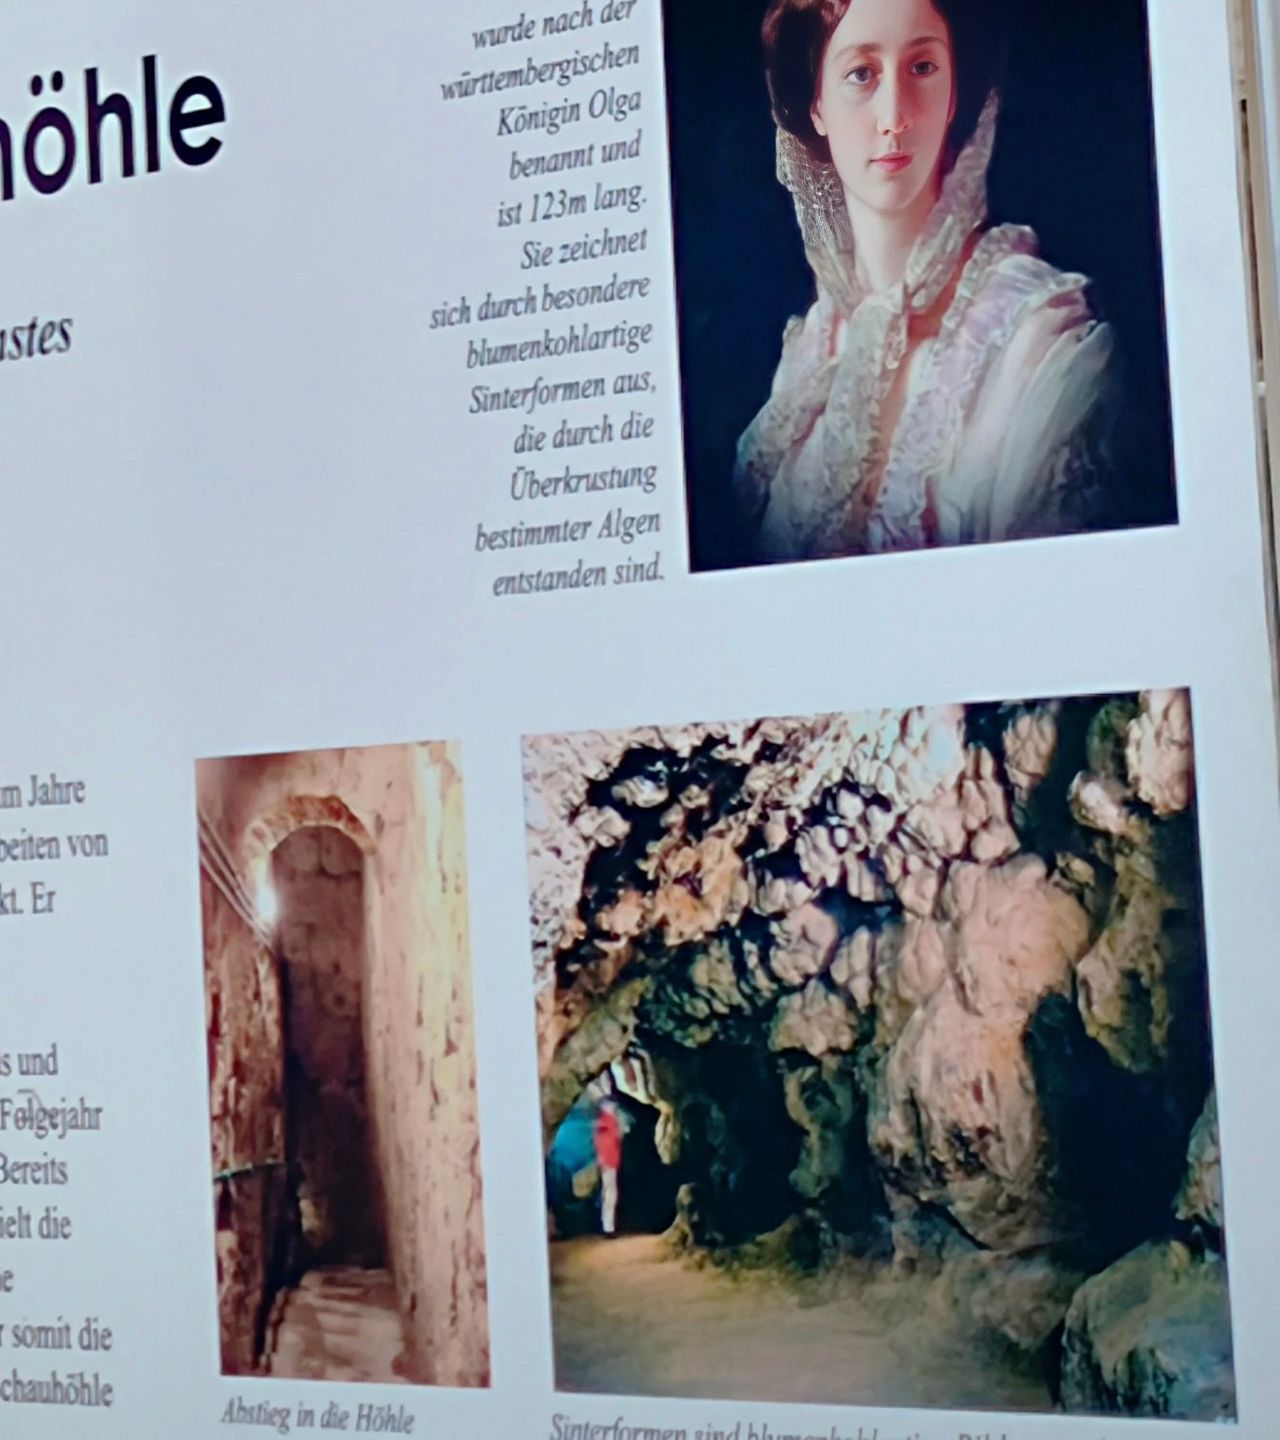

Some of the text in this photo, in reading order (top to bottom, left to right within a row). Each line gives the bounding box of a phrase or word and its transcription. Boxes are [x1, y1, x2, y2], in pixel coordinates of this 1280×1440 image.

[472, 12, 536, 50] wurde
[542, 0, 593, 36] nach
[440, 42, 640, 101] württembergischen
[496, 86, 642, 137] Königin Olga
[509, 128, 642, 181] benannt und
[497, 181, 648, 228] ist 123m lang.
[520, 227, 648, 271] Sie zeichnet
[429, 272, 651, 329] sich durch besondere
[466, 319, 652, 369] blumenkohlartige
[469, 370, 657, 416] Sinterformen aus,
[514, 410, 655, 454] die durch die
[510, 463, 658, 501] Überkrustung
[474, 507, 661, 553] bestimmter Algen
[492, 551, 665, 598] entstanden sind.
[27, 772, 86, 807] Jahre
[68, 832, 109, 858] von
[30, 880, 57, 915] Er
[18, 1042, 59, 1077] und
[0, 1096, 103, 1140] Folgejahr
[38, 1205, 72, 1240] die
[12, 1316, 72, 1350] somit
[78, 1316, 113, 1351] die
[220, 1396, 415, 1434] Abstieg in die Höhle
